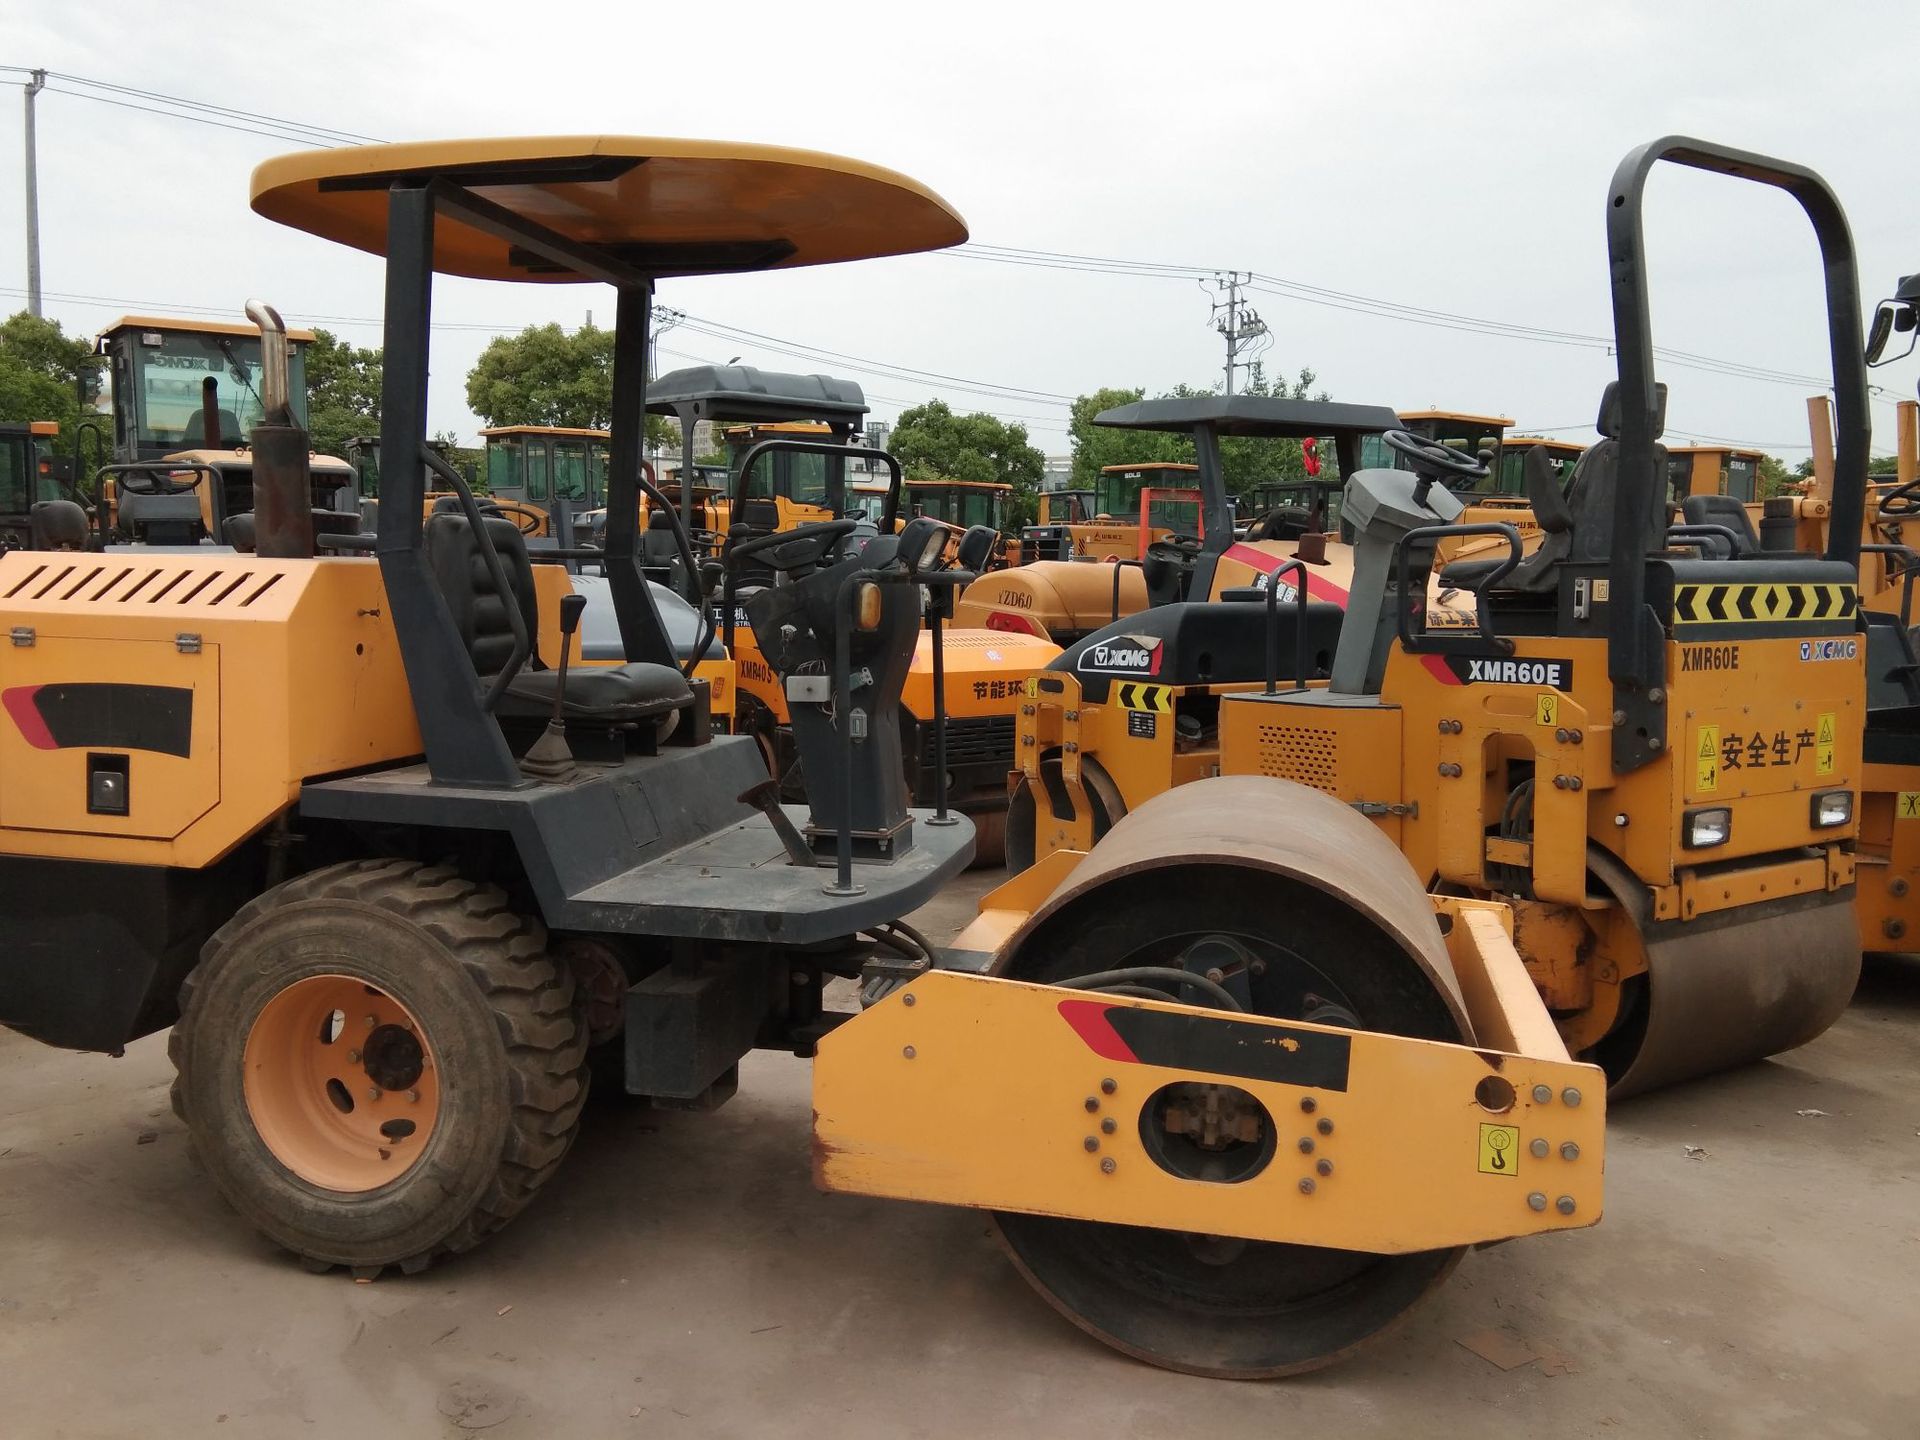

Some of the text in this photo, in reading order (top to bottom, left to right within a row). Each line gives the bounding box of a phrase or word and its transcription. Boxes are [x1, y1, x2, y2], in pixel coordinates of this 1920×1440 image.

[1108, 649, 1149, 666] XCMG
[1682, 646, 1740, 671] XMR60E
[1814, 640, 1857, 660] XCMG
[1468, 660, 1560, 685] XMR60E
[1721, 728, 1816, 772] 安全生产
